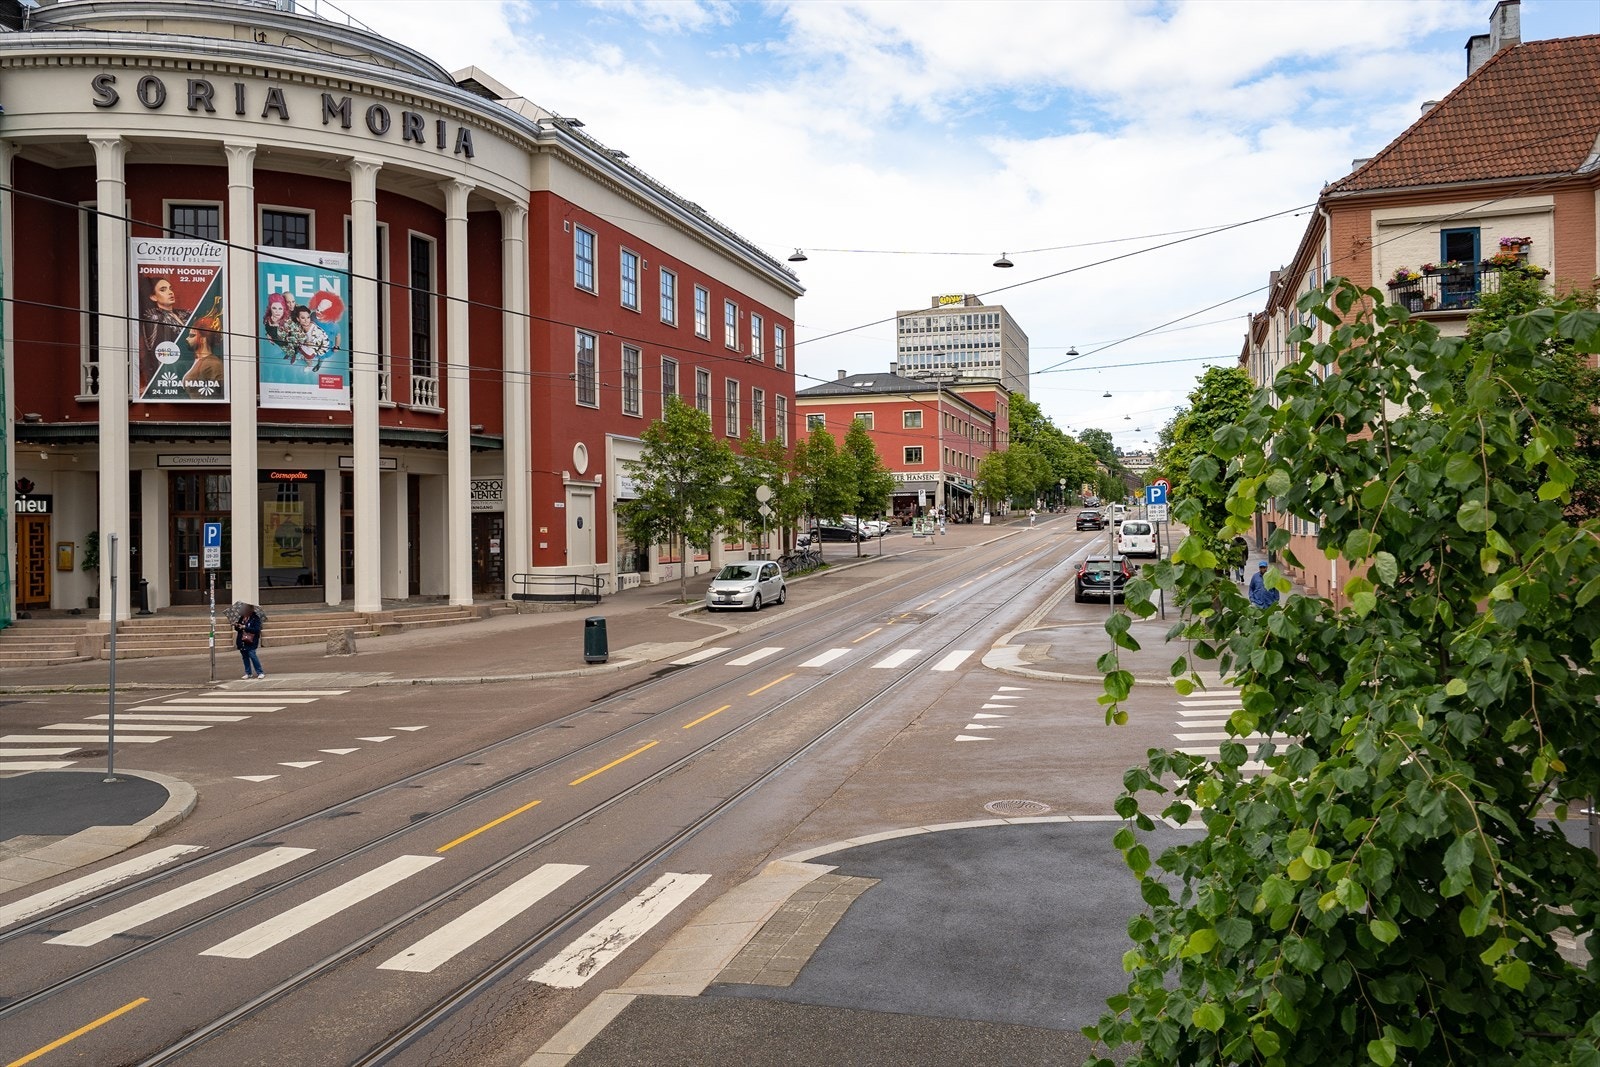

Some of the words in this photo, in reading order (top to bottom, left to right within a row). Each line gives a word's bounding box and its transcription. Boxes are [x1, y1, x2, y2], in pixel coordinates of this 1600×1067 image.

[91, 73, 290, 120] SORIA
[321, 92, 475, 159] MORIA
[137, 242, 222, 261] Cosmopolite
[139, 267, 175, 275] JOHNNY
[177, 268, 214, 276] HOOKER
[267, 273, 341, 298] HEN
[157, 379, 183, 387] FRIDA
[172, 456, 218, 464] Cosmopolite
[271, 471, 308, 481] Cosmopolite
[906, 473, 935, 481] HANSEN
[471, 481, 503, 490] ORSHOV
[1151, 488, 1161, 502] P
[208, 526, 217, 544] P
